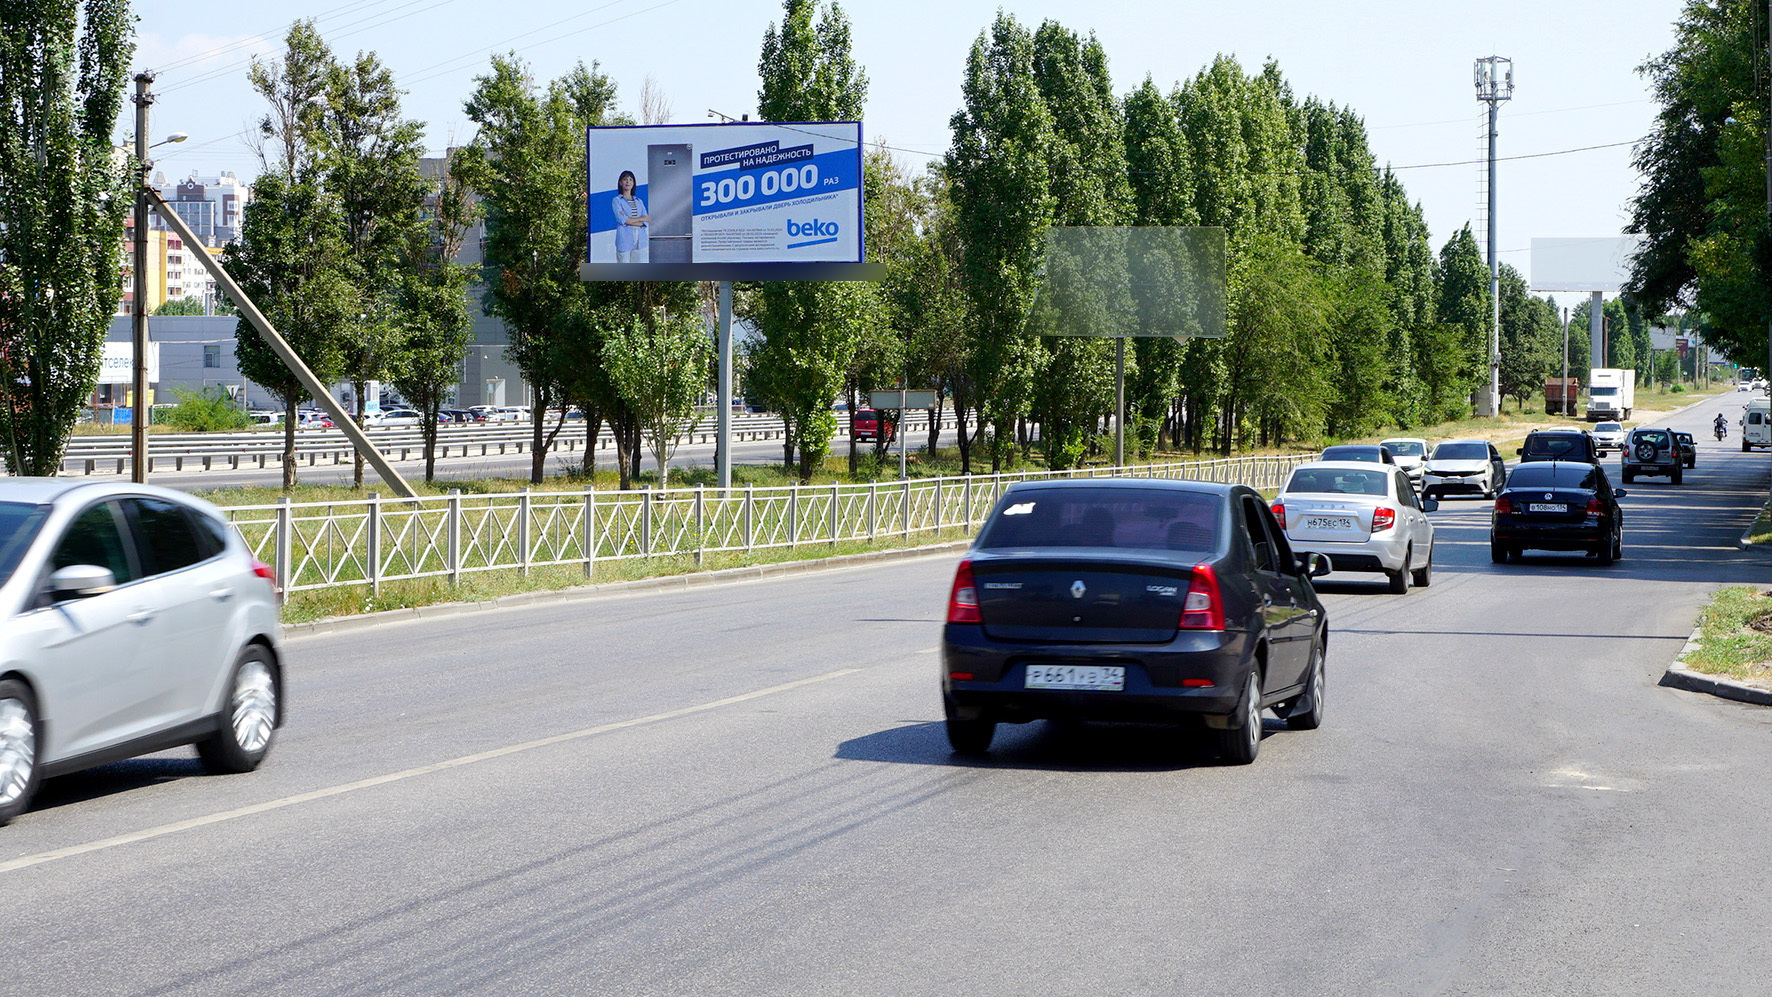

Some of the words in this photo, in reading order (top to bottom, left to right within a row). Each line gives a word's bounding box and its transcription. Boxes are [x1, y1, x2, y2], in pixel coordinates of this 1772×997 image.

[703, 145, 777, 165] ПРОТЕСТИРОВАНО
[742, 157, 755, 167] НА
[755, 148, 812, 165] НАДЕЖНОСТЬ
[700, 175, 756, 207] 300
[760, 164, 818, 196] 000
[823, 176, 840, 186] РАЗ
[700, 211, 734, 222] ОТКРЫВАЛИ
[739, 204, 773, 216] ЗАКРЫВАЛИ
[772, 201, 791, 211] ДВЕРЬ
[787, 218, 839, 237] beko
